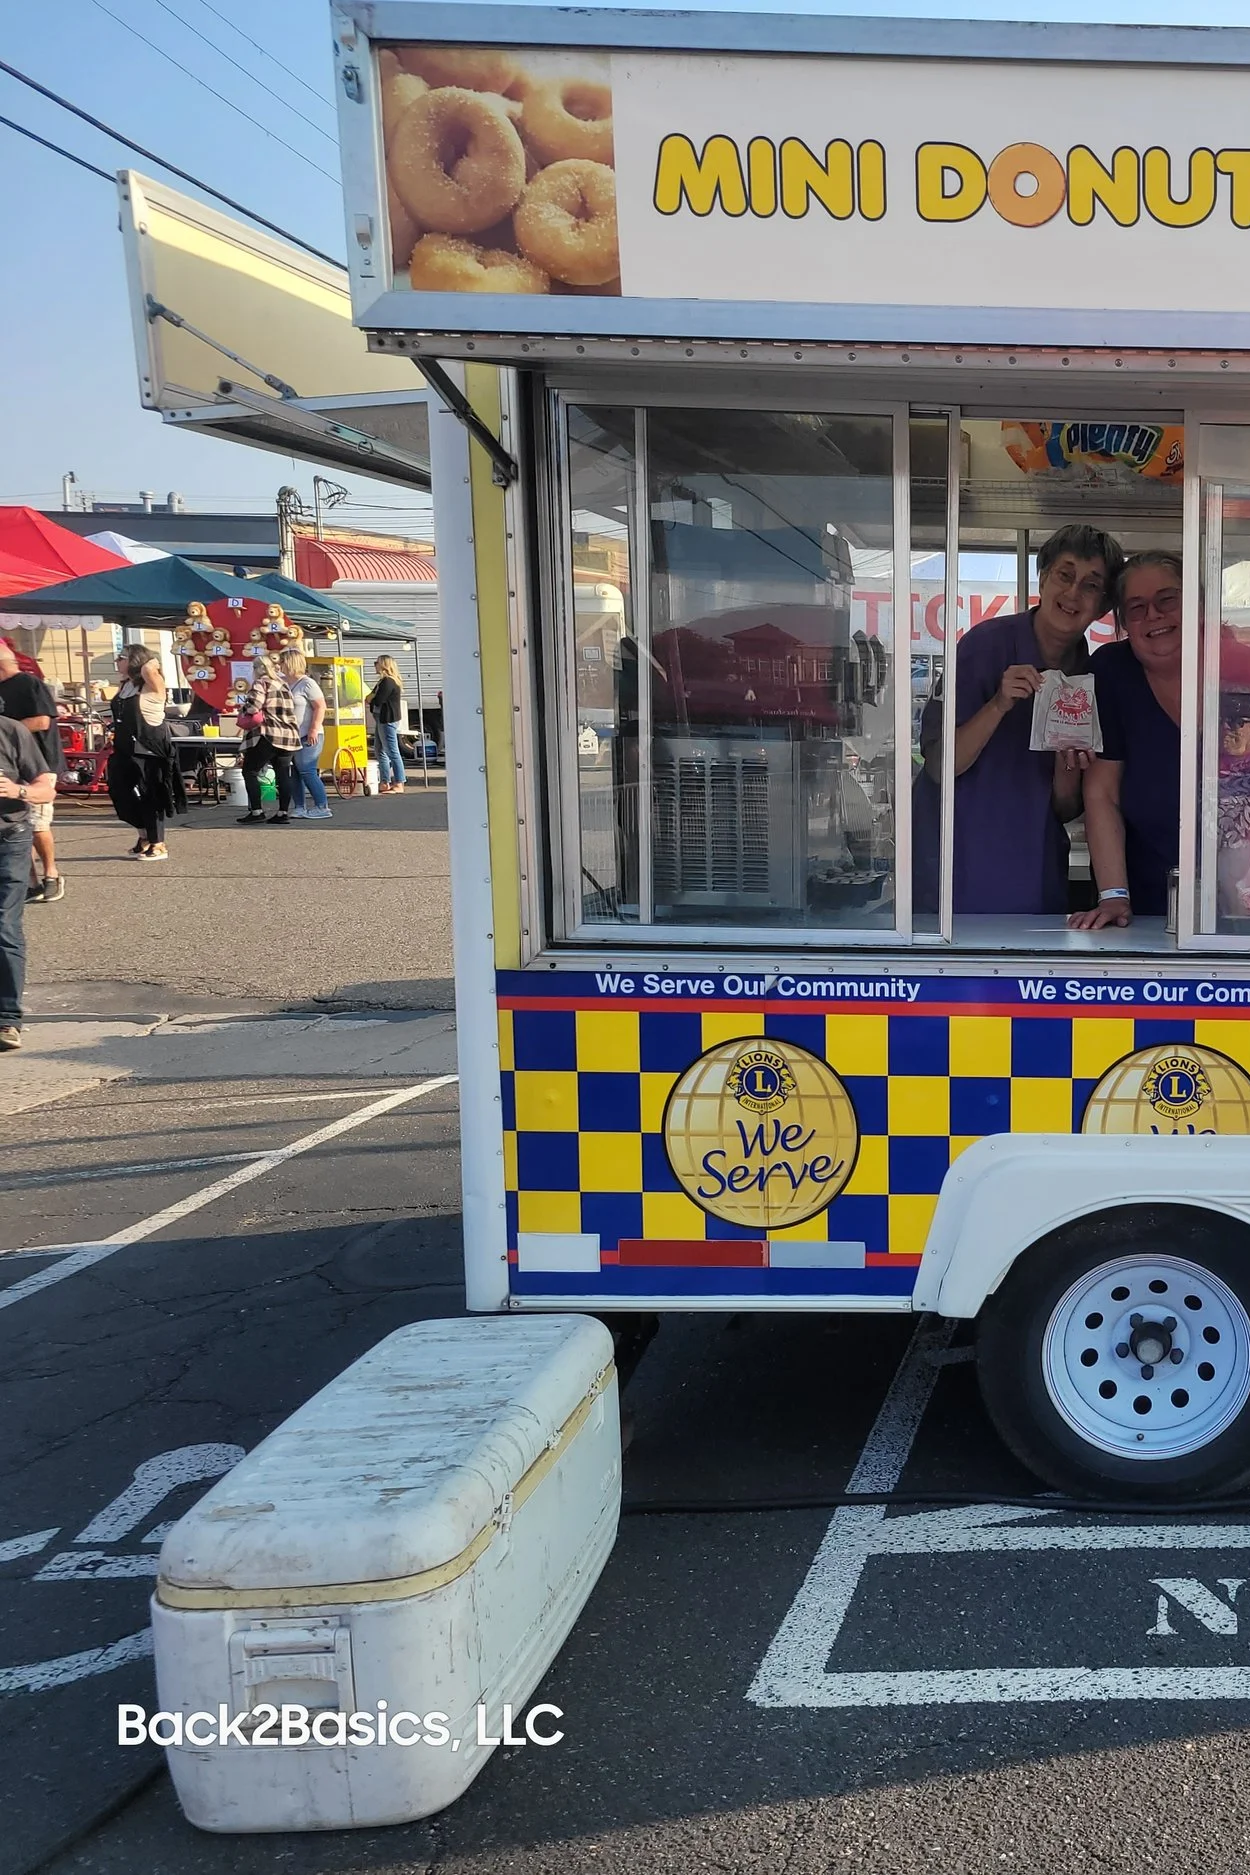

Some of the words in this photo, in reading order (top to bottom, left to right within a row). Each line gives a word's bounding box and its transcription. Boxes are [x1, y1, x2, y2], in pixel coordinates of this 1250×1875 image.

[653, 131, 886, 221] MINI
[595, 973, 635, 994] We
[643, 974, 715, 995] Serve
[776, 978, 921, 1002] Community
[1018, 979, 1057, 1000] We
[1064, 980, 1135, 1001] Serve
[1143, 981, 1188, 1002] Our
[741, 1053, 781, 1067] LIONS
[1158, 1059, 1197, 1072] LIONS
[754, 1070, 772, 1092] L
[1169, 1076, 1187, 1098] L
[742, 1098, 781, 1110] INTERNATIONAL
[1157, 1103, 1196, 1115] INTERNATIONAL
[736, 1119, 816, 1159] We
[697, 1149, 845, 1199] Serve
